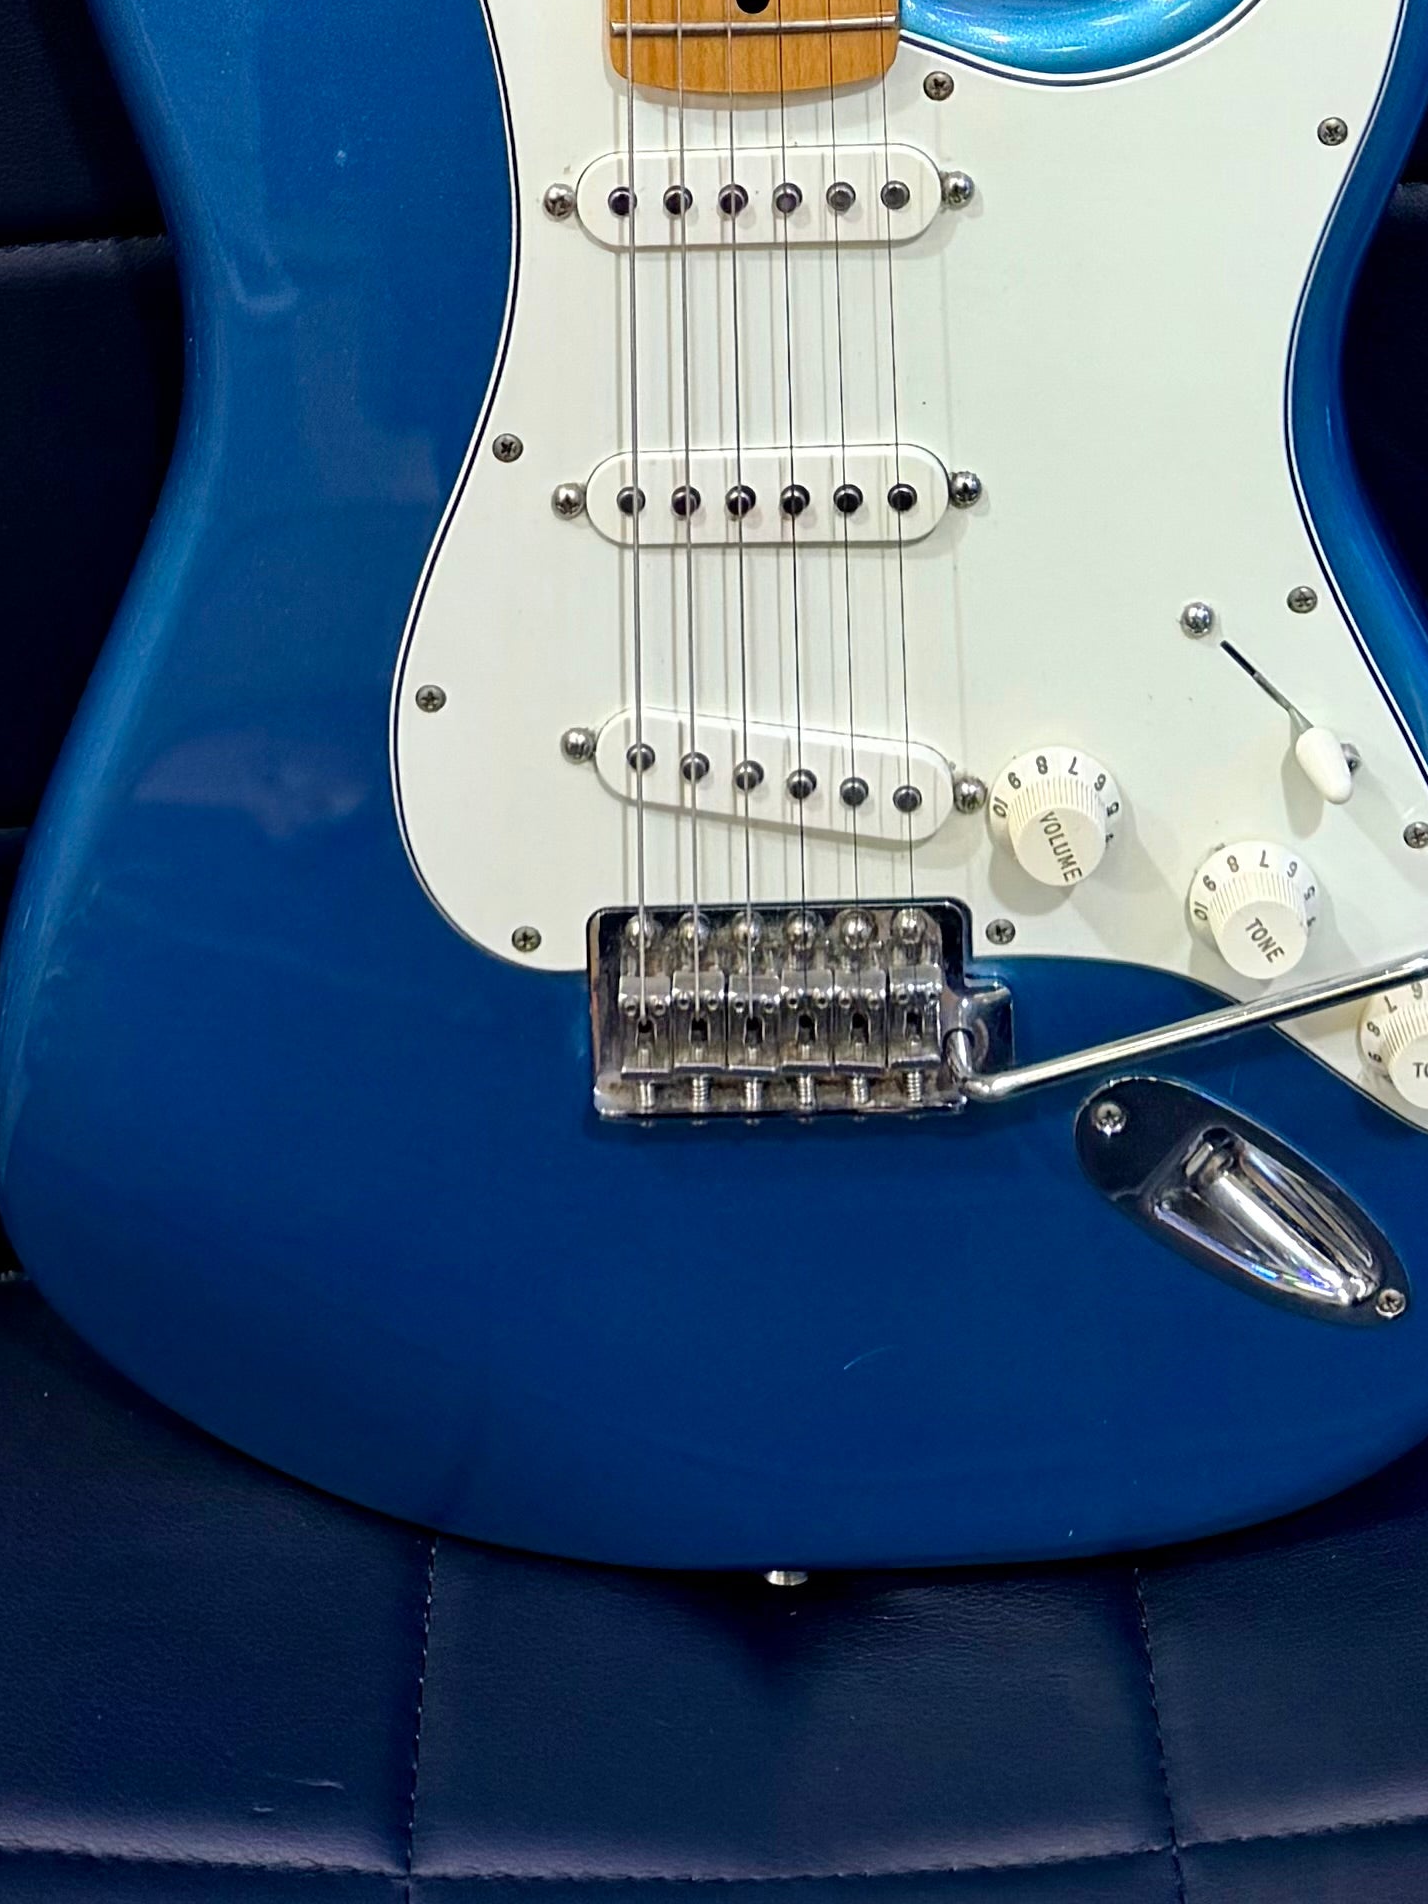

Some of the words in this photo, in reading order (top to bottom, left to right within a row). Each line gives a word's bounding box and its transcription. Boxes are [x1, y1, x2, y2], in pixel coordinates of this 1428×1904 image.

[1035, 754, 1049, 775] 8
[1067, 756, 1079, 776] 7
[1038, 810, 1083, 883] VOLUME
[1226, 854, 1240, 873] 8
[1259, 849, 1270, 869] 7
[1245, 916, 1285, 964] TONE
[1366, 1020, 1381, 1038] 8
[1383, 994, 1398, 1014] 7
